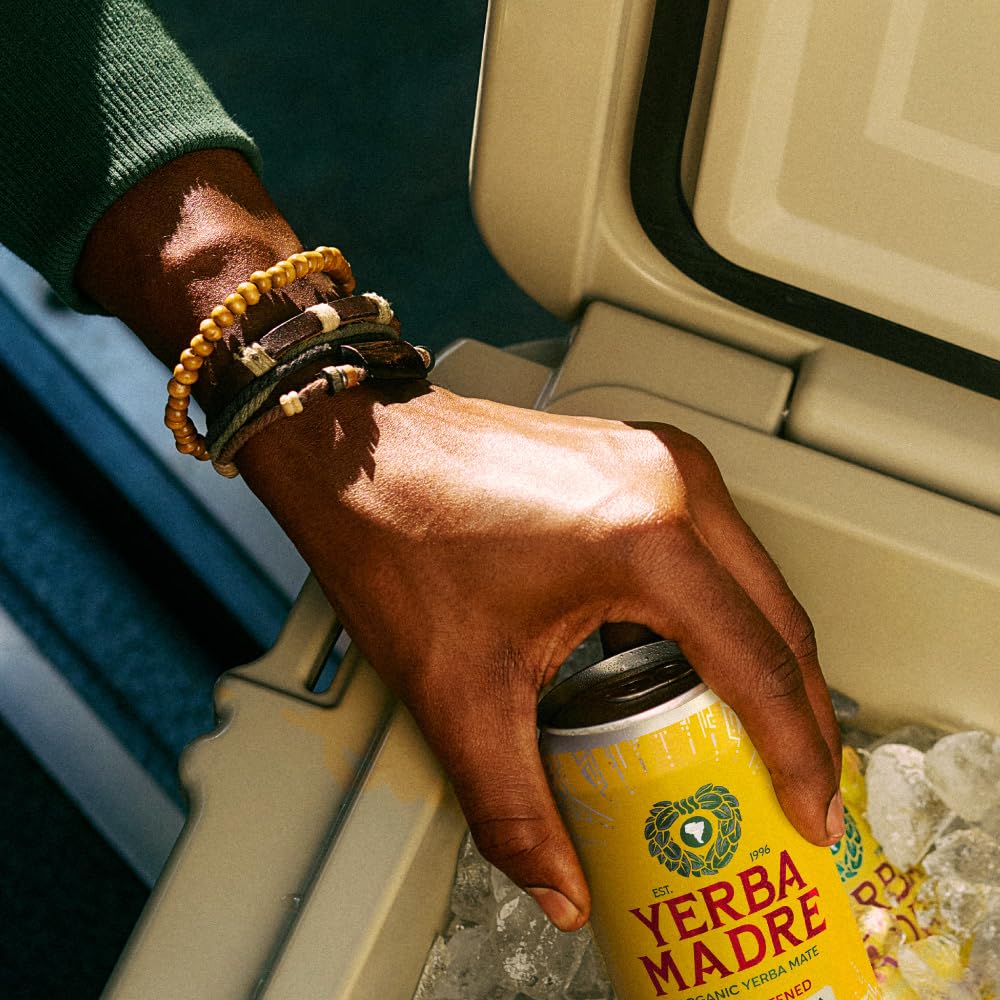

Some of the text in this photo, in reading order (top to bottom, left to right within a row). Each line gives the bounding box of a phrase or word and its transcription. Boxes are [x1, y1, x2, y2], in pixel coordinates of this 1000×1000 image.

[628, 849, 808, 947] YERBA
[652, 844, 771, 898] EST. 1996
[638, 887, 827, 997] MADRE
[742, 965, 788, 990] YERBA
[788, 945, 820, 970] MATE
